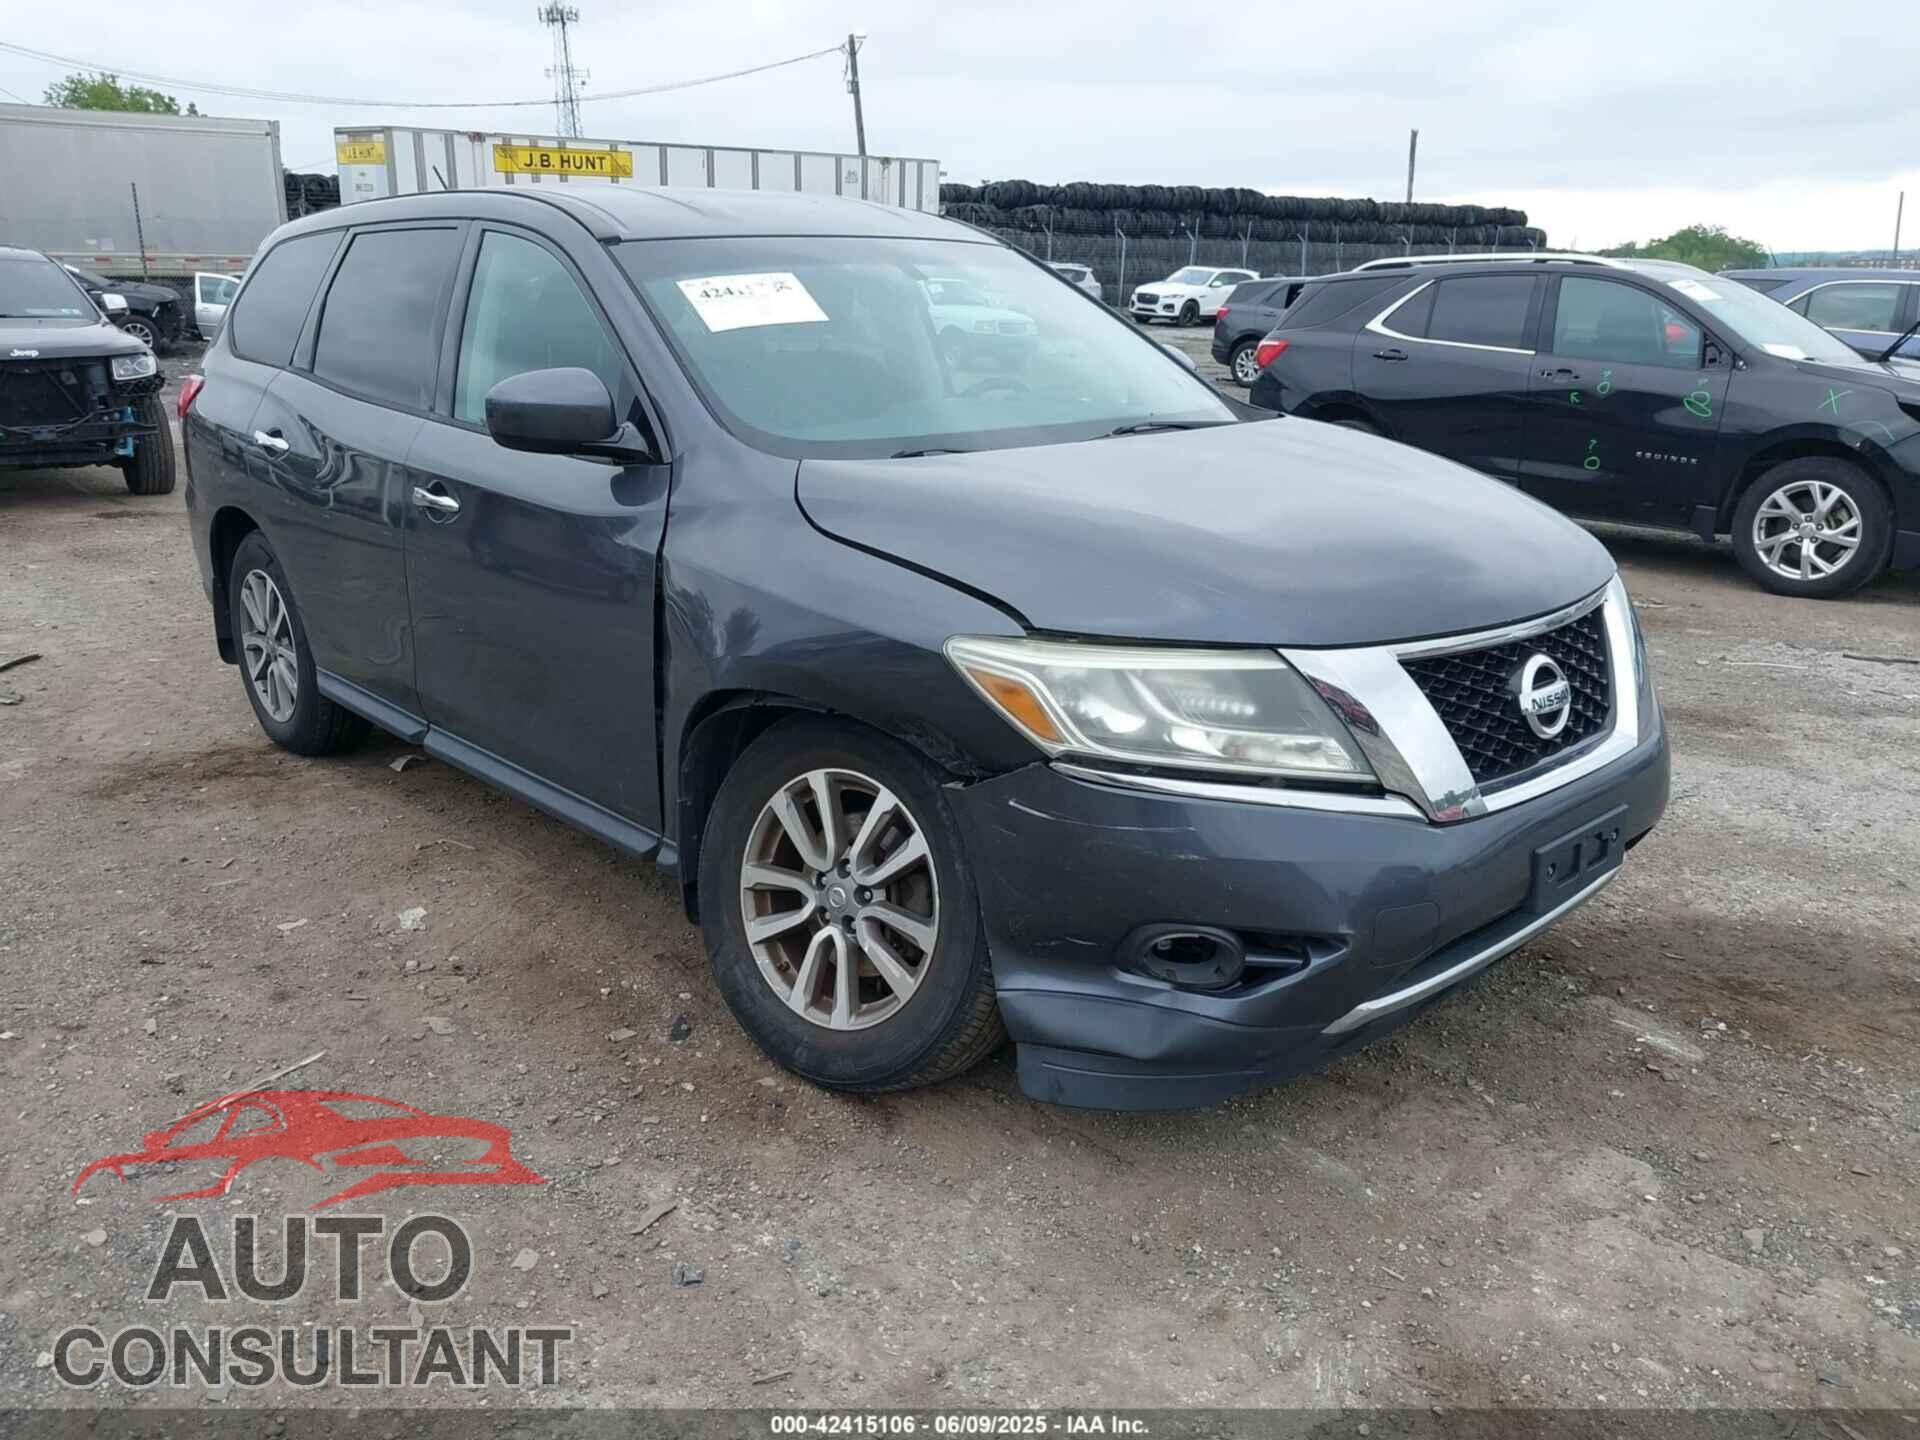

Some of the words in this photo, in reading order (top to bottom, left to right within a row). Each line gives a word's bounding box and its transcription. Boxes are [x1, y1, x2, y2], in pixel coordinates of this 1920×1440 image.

[523, 152, 556, 168] J.B.
[560, 154, 606, 171] HUNT
[10, 349, 39, 357] Jeep
[1531, 687, 1570, 710] NISSAN
